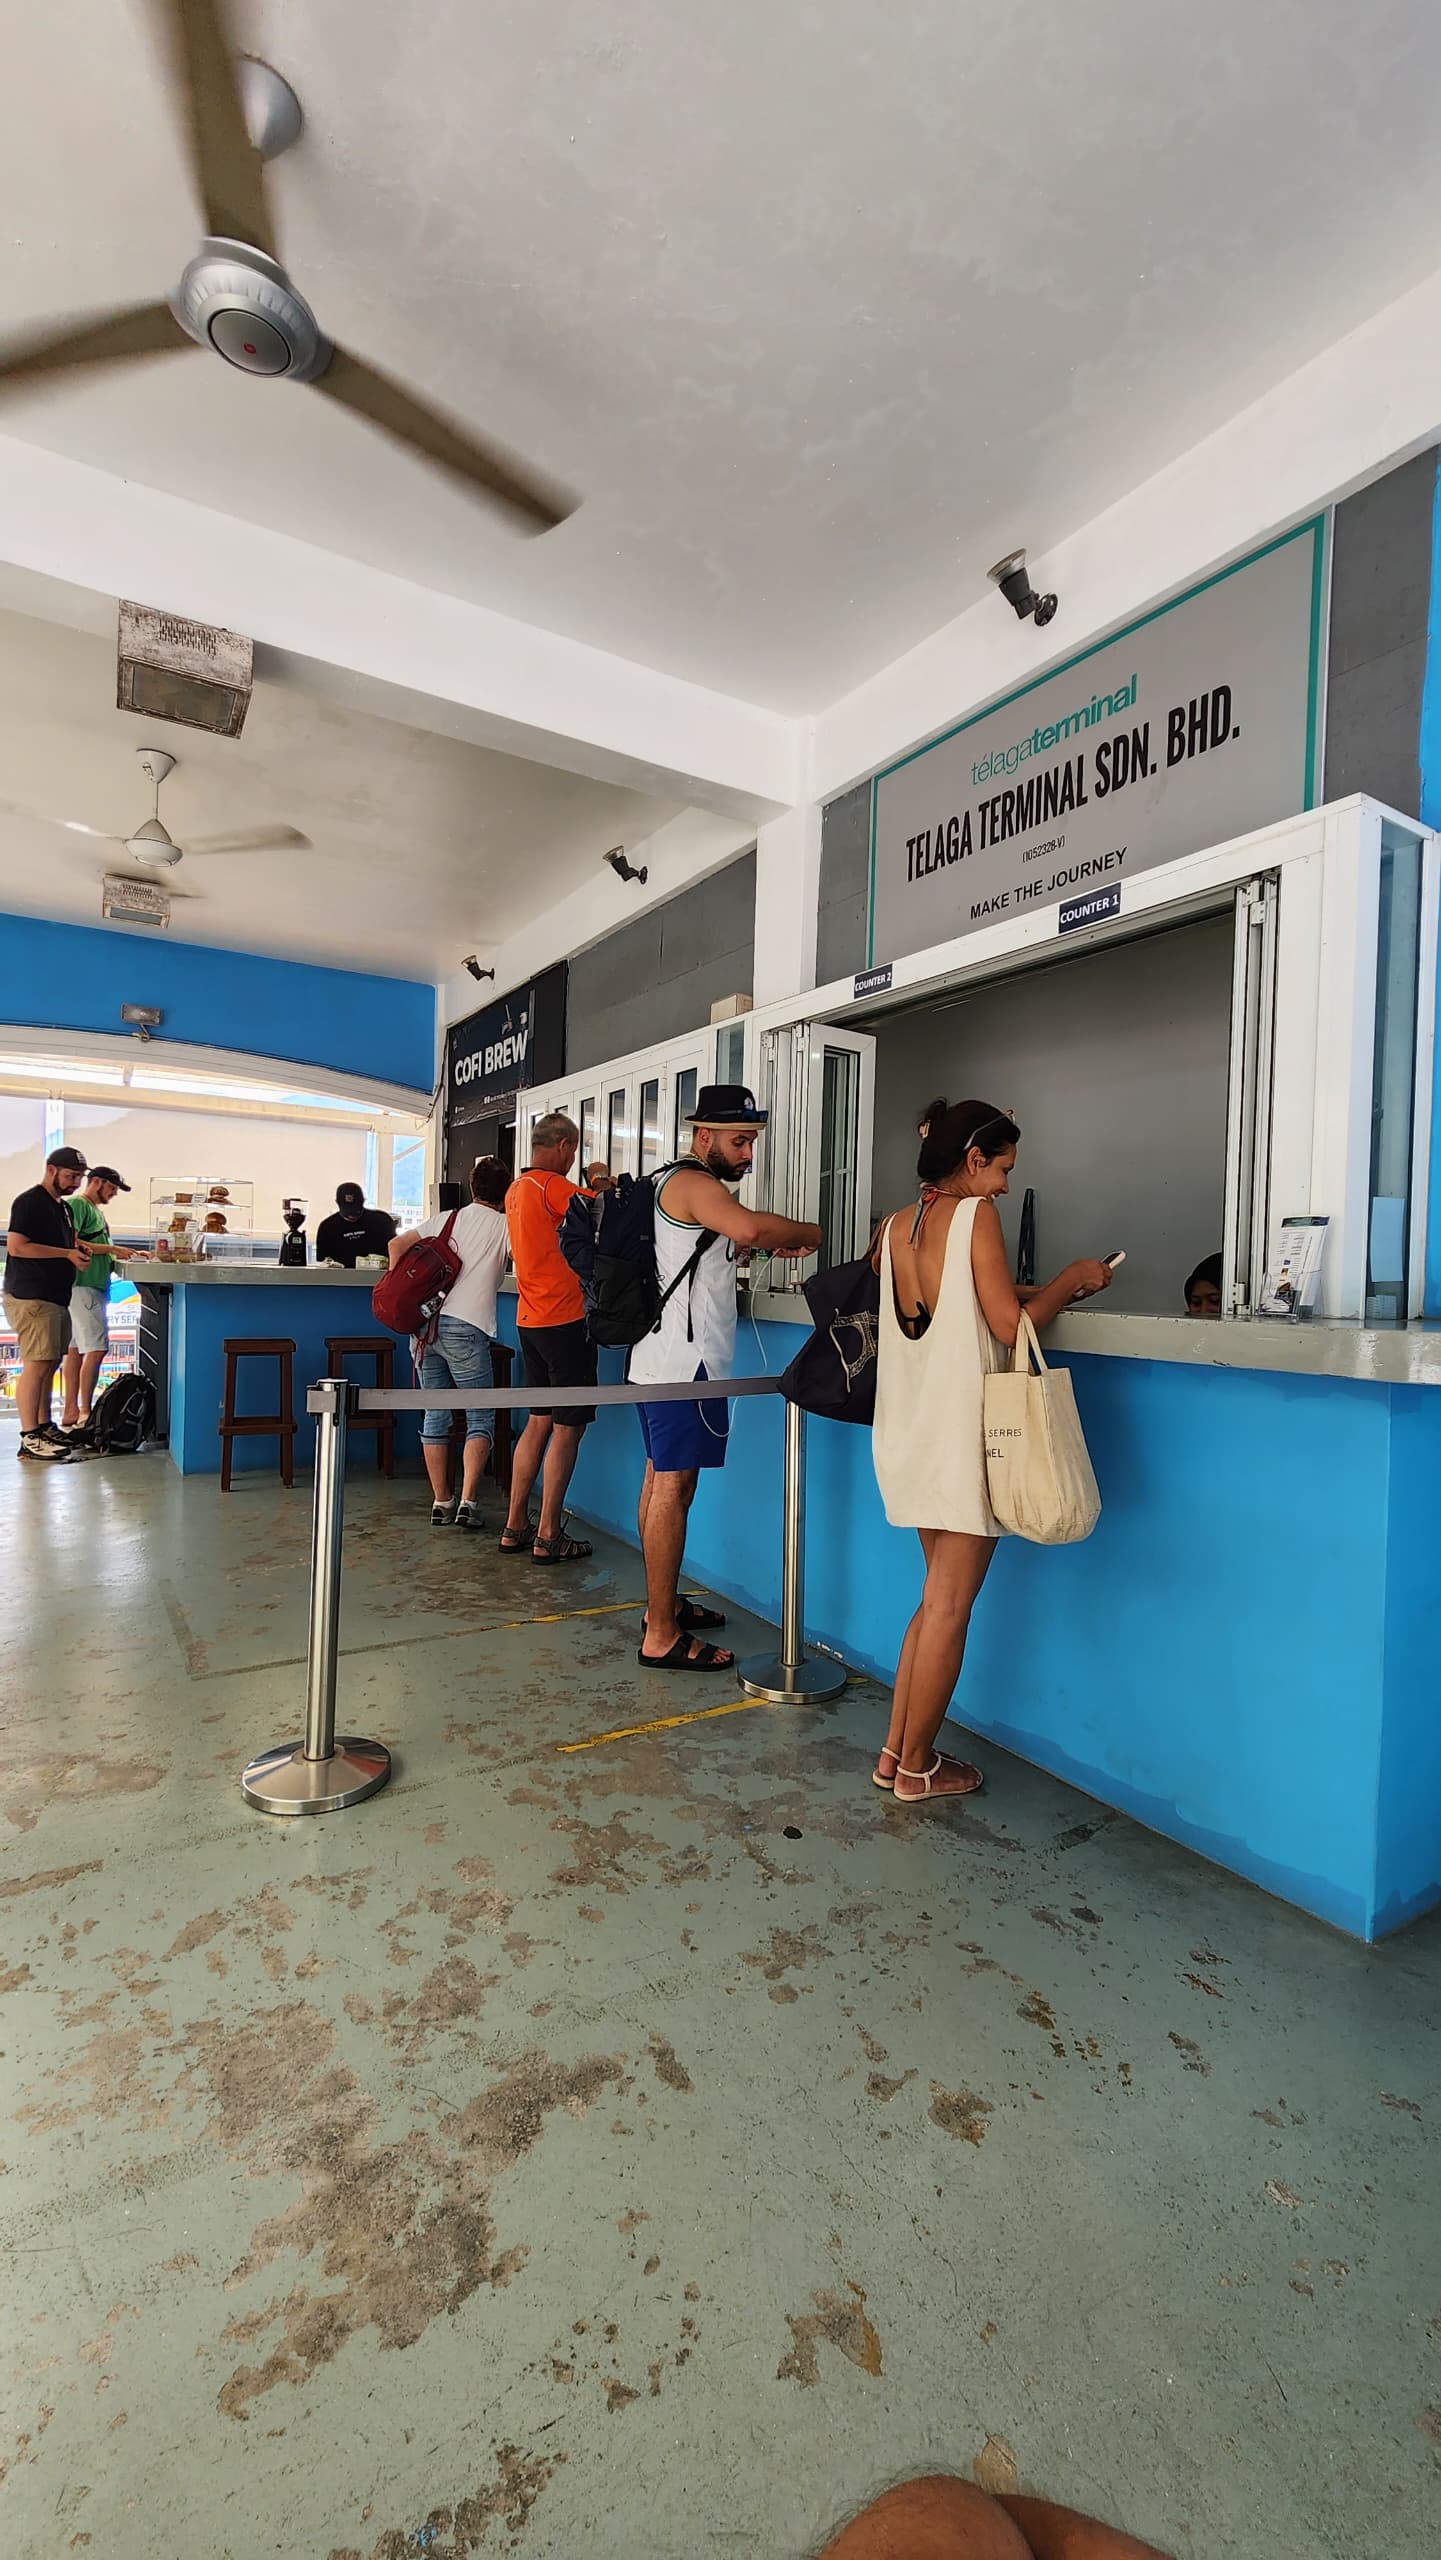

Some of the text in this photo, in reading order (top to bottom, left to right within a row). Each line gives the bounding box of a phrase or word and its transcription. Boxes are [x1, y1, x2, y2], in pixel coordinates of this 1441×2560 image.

[971, 673, 1137, 785] télagaterminal
[906, 685, 1240, 882] TELAGA TERMINAL SDN. BHD.
[1022, 835, 1065, 863] (1052328-V)
[971, 846, 1127, 920] MAKE THE JOURNEY
[1060, 894, 1119, 924] COUNTER 1
[855, 972, 892, 991] COUNTER 2
[455, 1029, 528, 1086] COFI BREW
[988, 1428, 1022, 1438] SERRES
